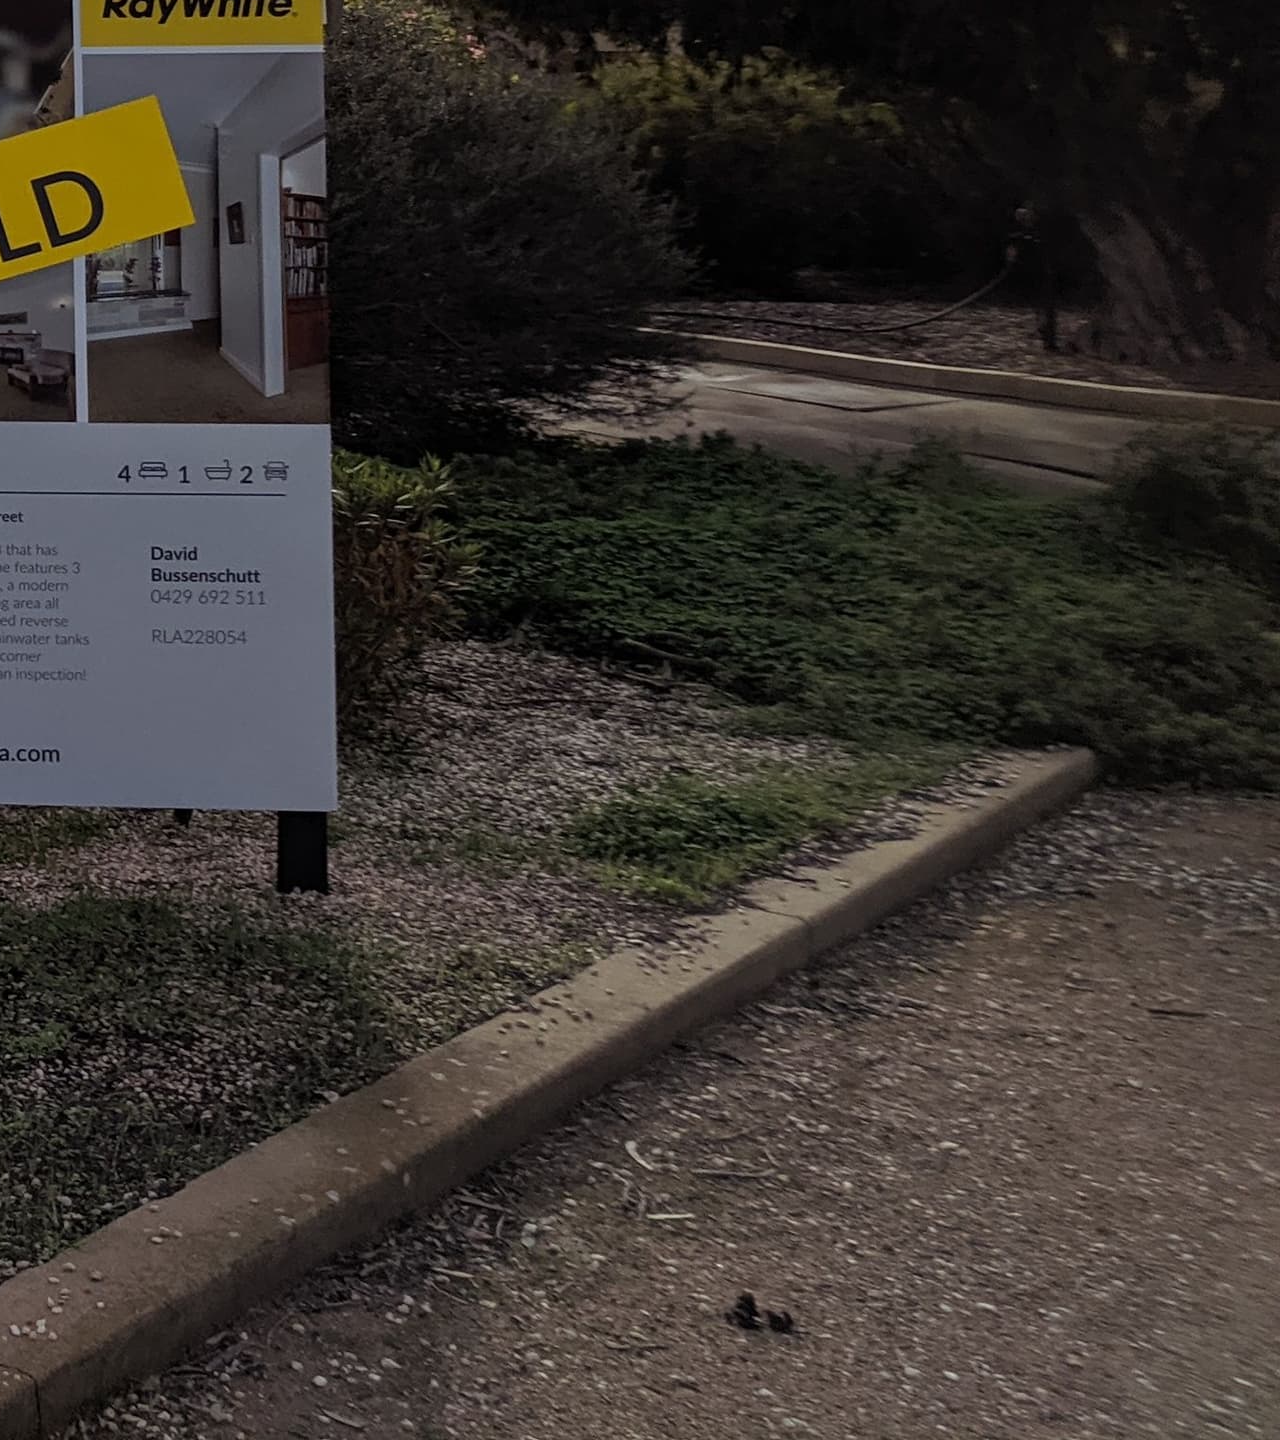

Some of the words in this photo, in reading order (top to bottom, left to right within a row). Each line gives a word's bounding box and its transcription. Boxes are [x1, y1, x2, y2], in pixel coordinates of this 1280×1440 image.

[117, 465, 132, 483] 4
[178, 466, 191, 484] 1
[240, 466, 254, 484] 2
[6, 544, 32, 556] that
[35, 544, 58, 556] has
[150, 546, 198, 561] David
[14, 561, 69, 574] features
[72, 562, 81, 574] 3
[150, 568, 261, 583] Bussenschutt
[18, 578, 69, 591] modern
[13, 599, 41, 609] area
[44, 597, 59, 609] all
[150, 589, 192, 604] 0429
[198, 590, 229, 604] 692
[235, 590, 266, 605] 511
[19, 617, 69, 627] reverse
[54, 633, 90, 645] tanks
[151, 629, 248, 645] RLA228054
